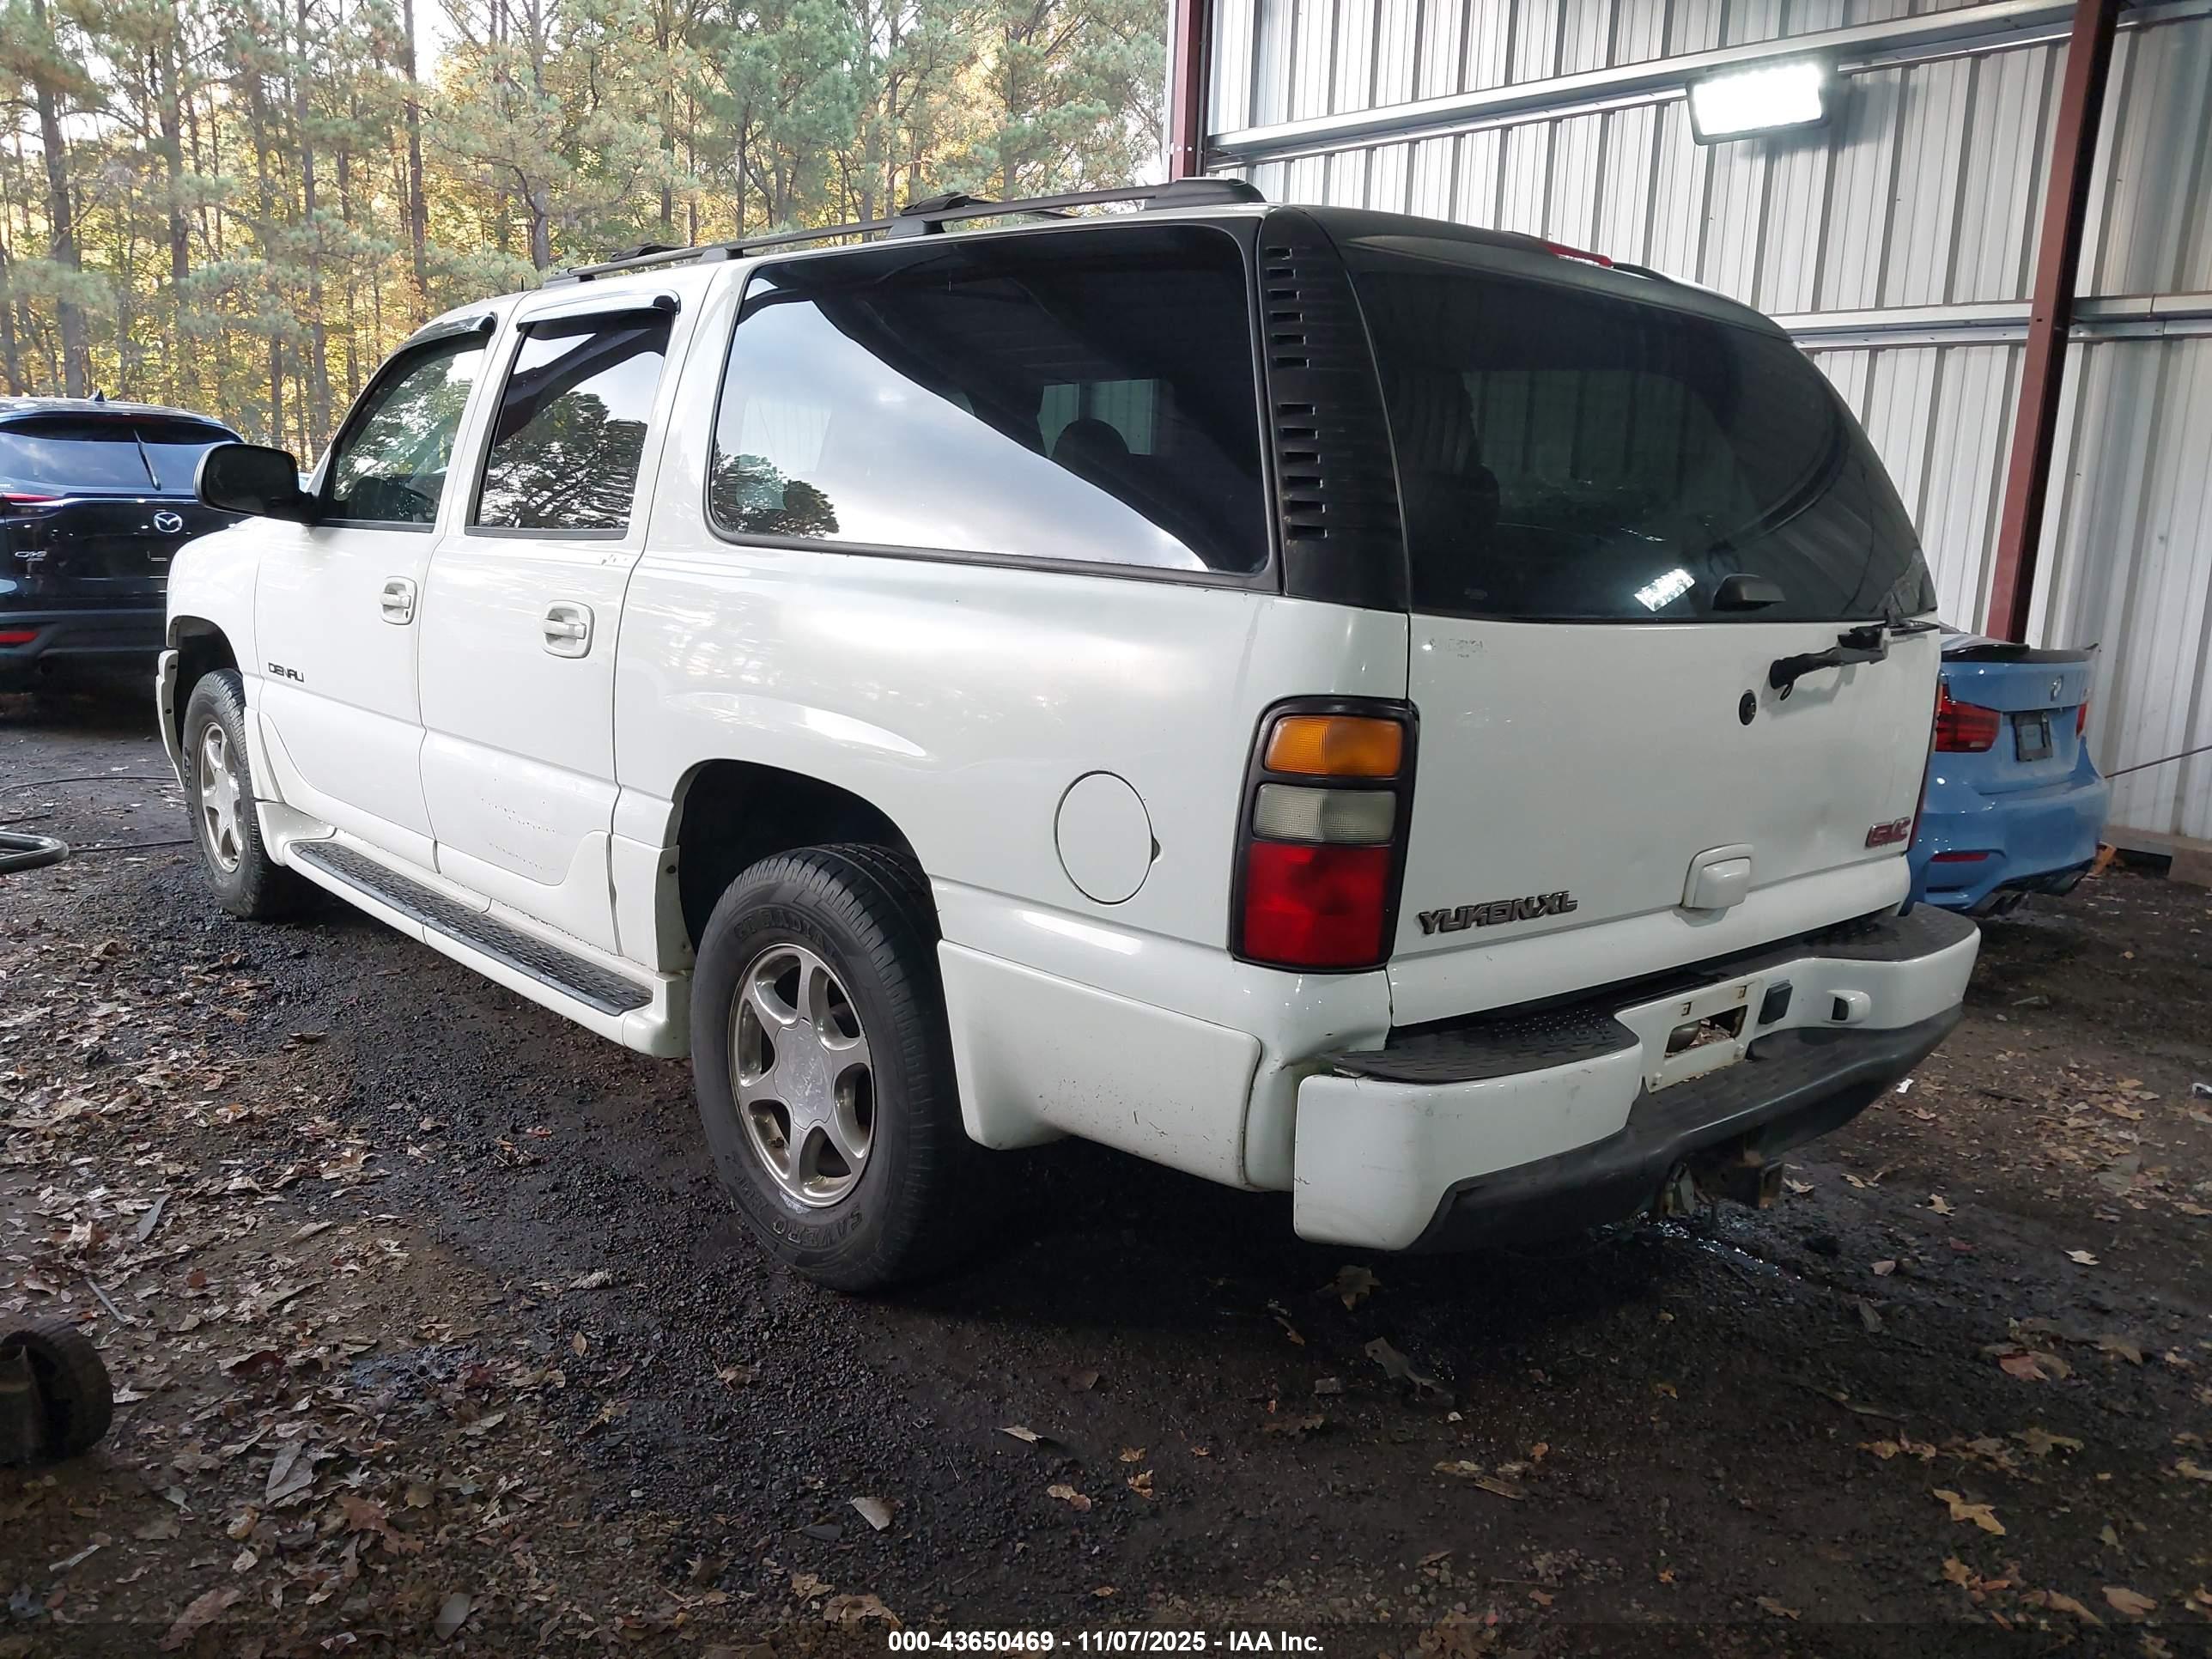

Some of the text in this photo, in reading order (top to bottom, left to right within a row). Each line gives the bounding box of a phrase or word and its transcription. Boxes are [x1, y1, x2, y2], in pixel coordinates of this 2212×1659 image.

[268, 661, 305, 683] DENALI
[1864, 817, 1912, 848] GMC
[1418, 890, 1578, 934] YUKON XL
